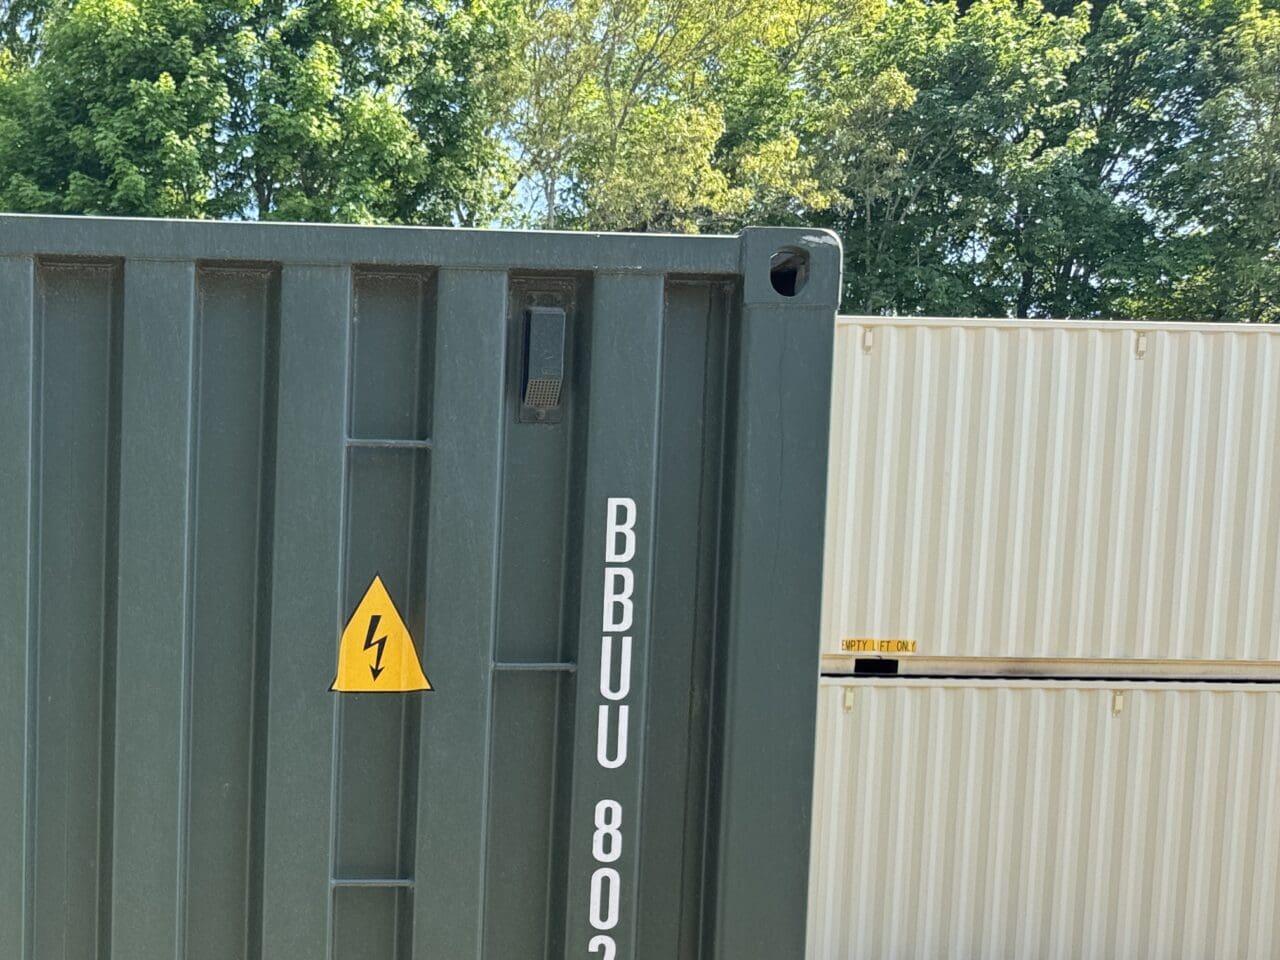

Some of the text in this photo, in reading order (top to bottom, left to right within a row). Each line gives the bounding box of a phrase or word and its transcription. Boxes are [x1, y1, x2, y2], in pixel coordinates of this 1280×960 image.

[597, 497, 637, 769] BBUU
[841, 639, 868, 652] EMPTY
[896, 641, 917, 653] ONLY
